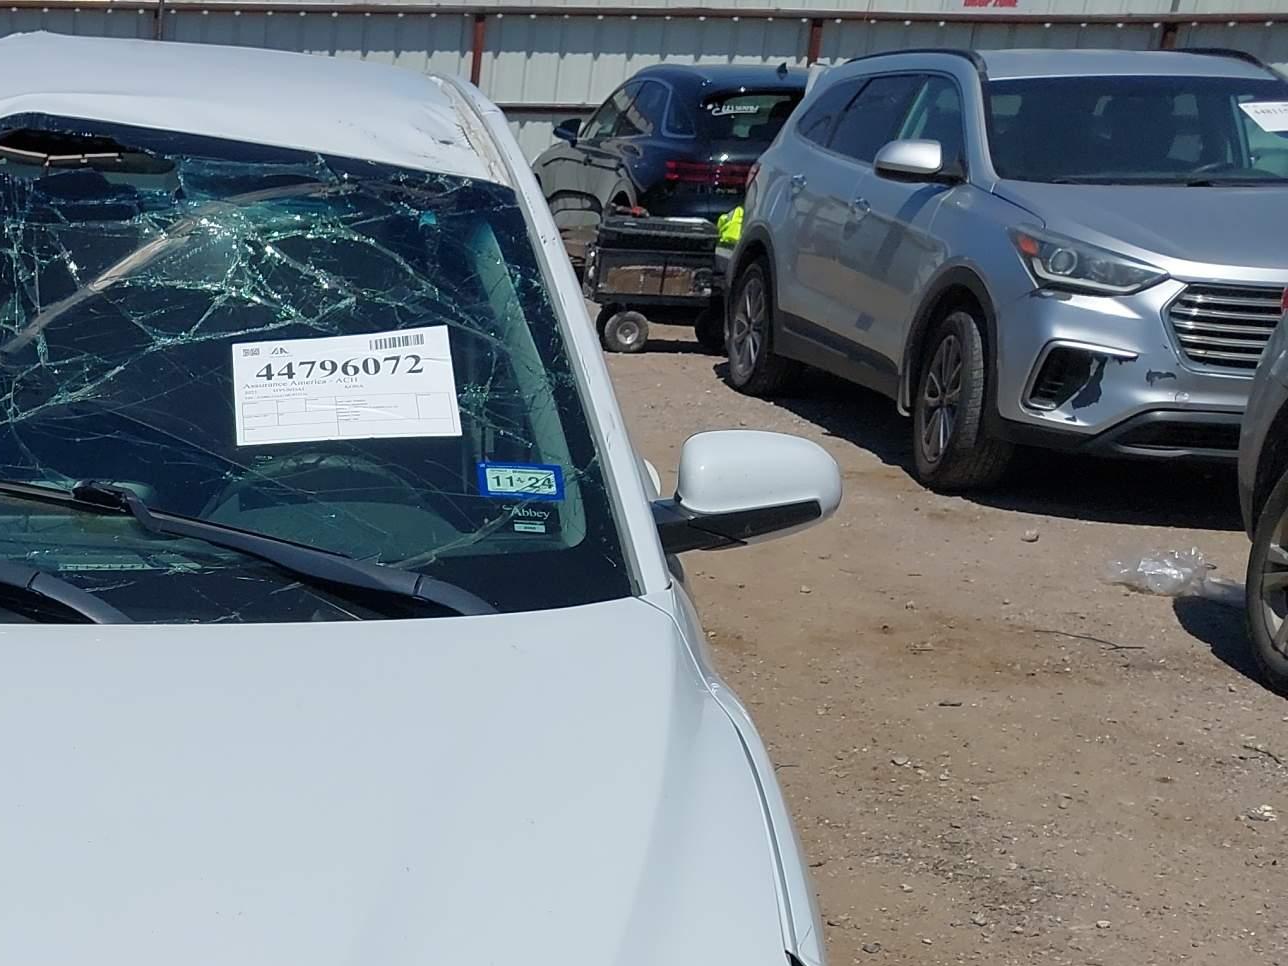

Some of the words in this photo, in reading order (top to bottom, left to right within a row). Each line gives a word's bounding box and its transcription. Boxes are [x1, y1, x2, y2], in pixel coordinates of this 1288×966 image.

[255, 354, 425, 381] 44796072
[243, 382, 288, 390] Assurance
[290, 379, 327, 387] America
[511, 506, 551, 520] Abbey
